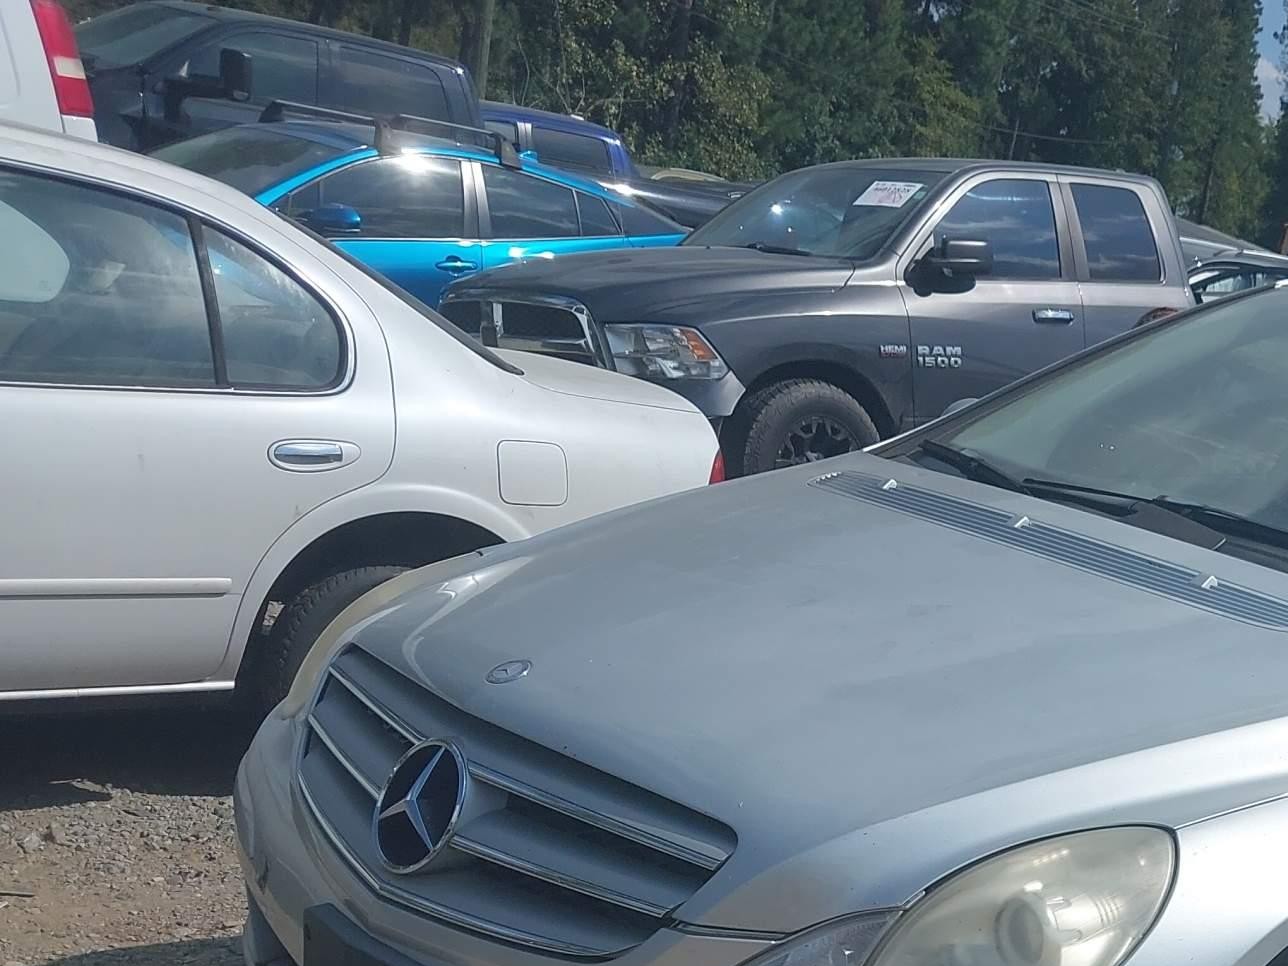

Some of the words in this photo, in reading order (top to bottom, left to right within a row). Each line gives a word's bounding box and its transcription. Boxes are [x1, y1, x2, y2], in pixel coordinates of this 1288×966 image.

[880, 344, 907, 354] HEMI
[917, 345, 962, 356] RAM
[917, 356, 962, 368] 1500
